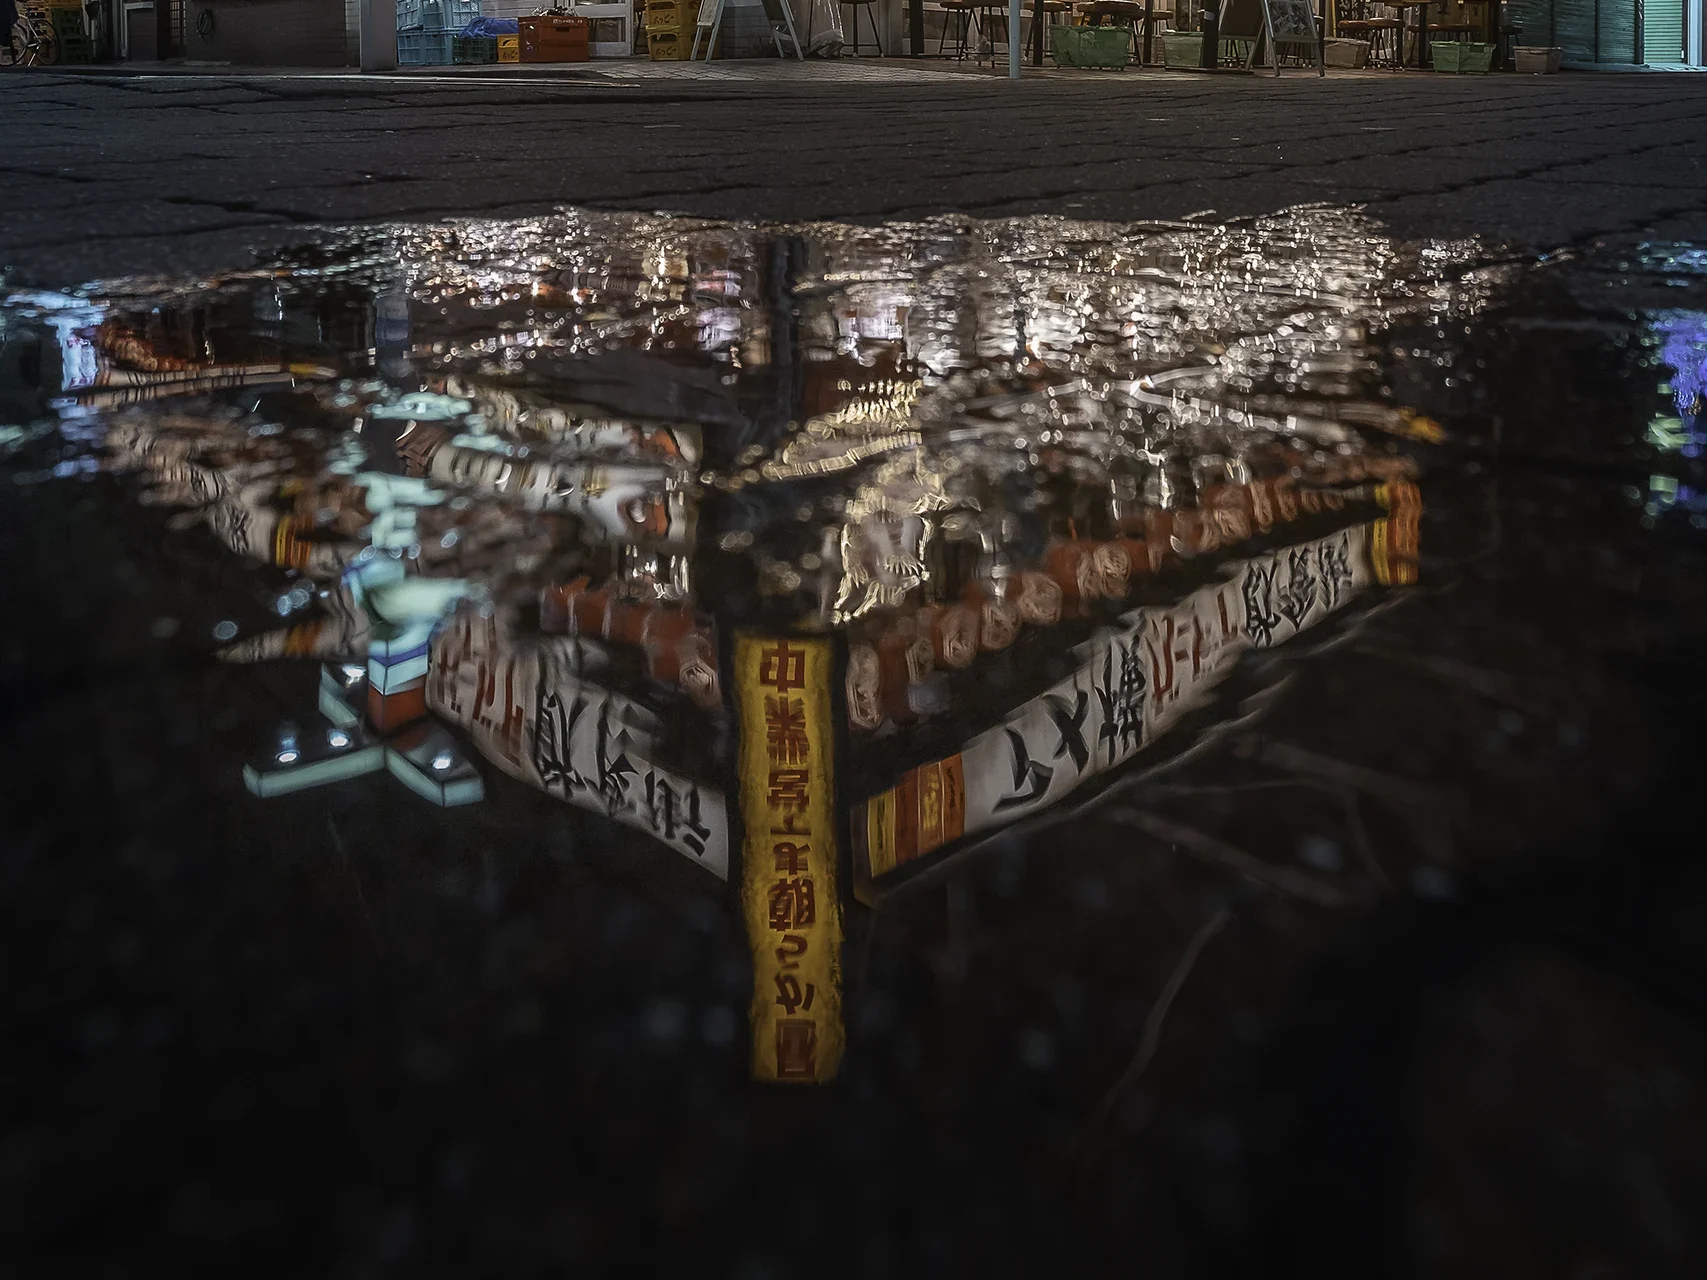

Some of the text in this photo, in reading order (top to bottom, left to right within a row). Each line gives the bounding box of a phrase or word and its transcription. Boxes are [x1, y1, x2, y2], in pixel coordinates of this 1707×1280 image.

[653, 13, 674, 24] ホッピー
[656, 46, 677, 57] ホッピー
